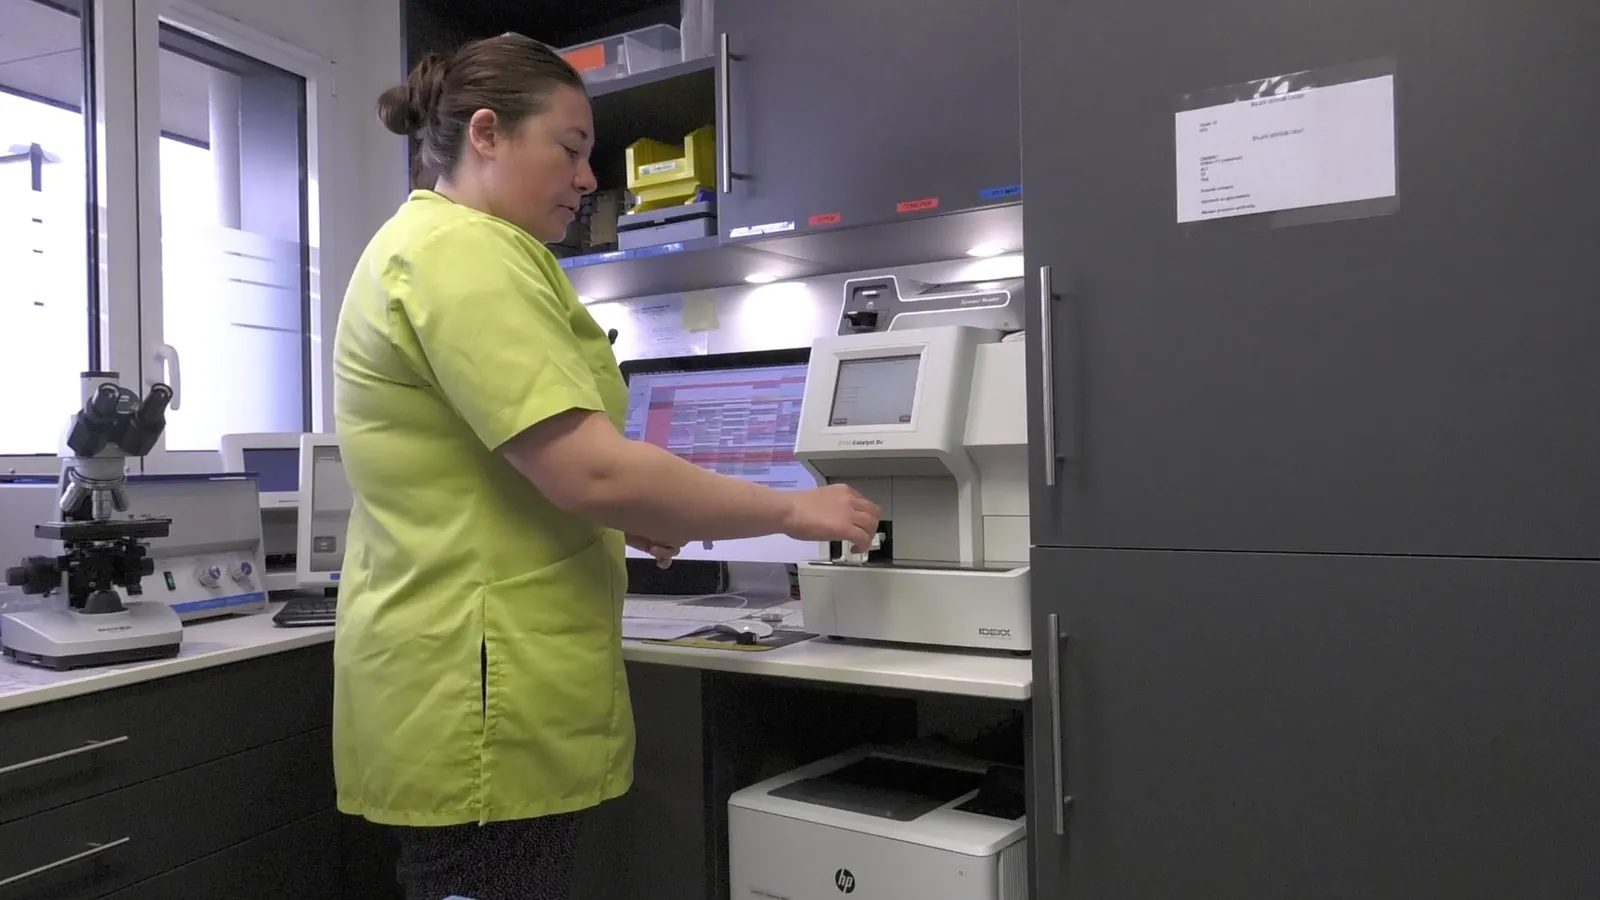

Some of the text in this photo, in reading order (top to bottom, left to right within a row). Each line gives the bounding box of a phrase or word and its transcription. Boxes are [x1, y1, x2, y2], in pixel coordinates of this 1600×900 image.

[852, 439, 875, 448] Catalyst
[978, 627, 1011, 637] IDEXX
[837, 868, 853, 893] hp
